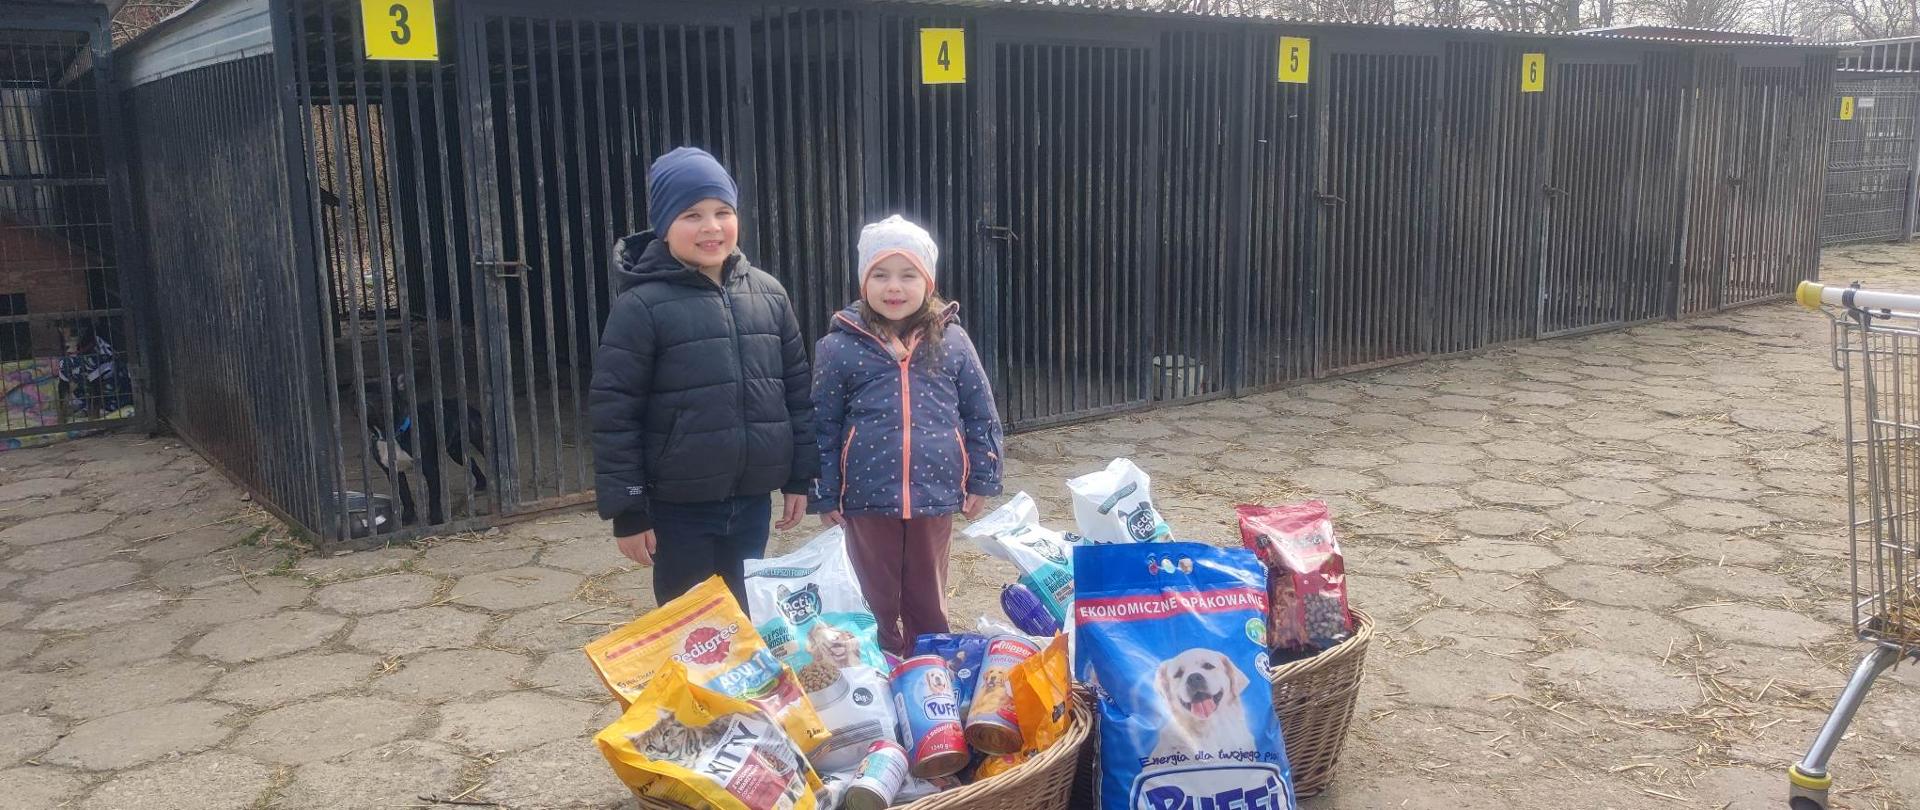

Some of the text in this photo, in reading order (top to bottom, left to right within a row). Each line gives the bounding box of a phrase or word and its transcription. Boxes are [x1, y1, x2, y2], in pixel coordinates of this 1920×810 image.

[389, 3, 411, 45] 3
[937, 40, 950, 71] 4
[1290, 46, 1299, 73] 5
[1530, 60, 1537, 83] 6
[1139, 520, 1155, 537] Pet
[783, 595, 809, 612] Acti
[1079, 594, 1264, 618] EKONOMICZNE OPAKOWANIE
[671, 623, 739, 664] Pedigree
[1139, 751, 1190, 768] Energia
[1194, 750, 1214, 761] dla
[1218, 749, 1262, 763] twojego
